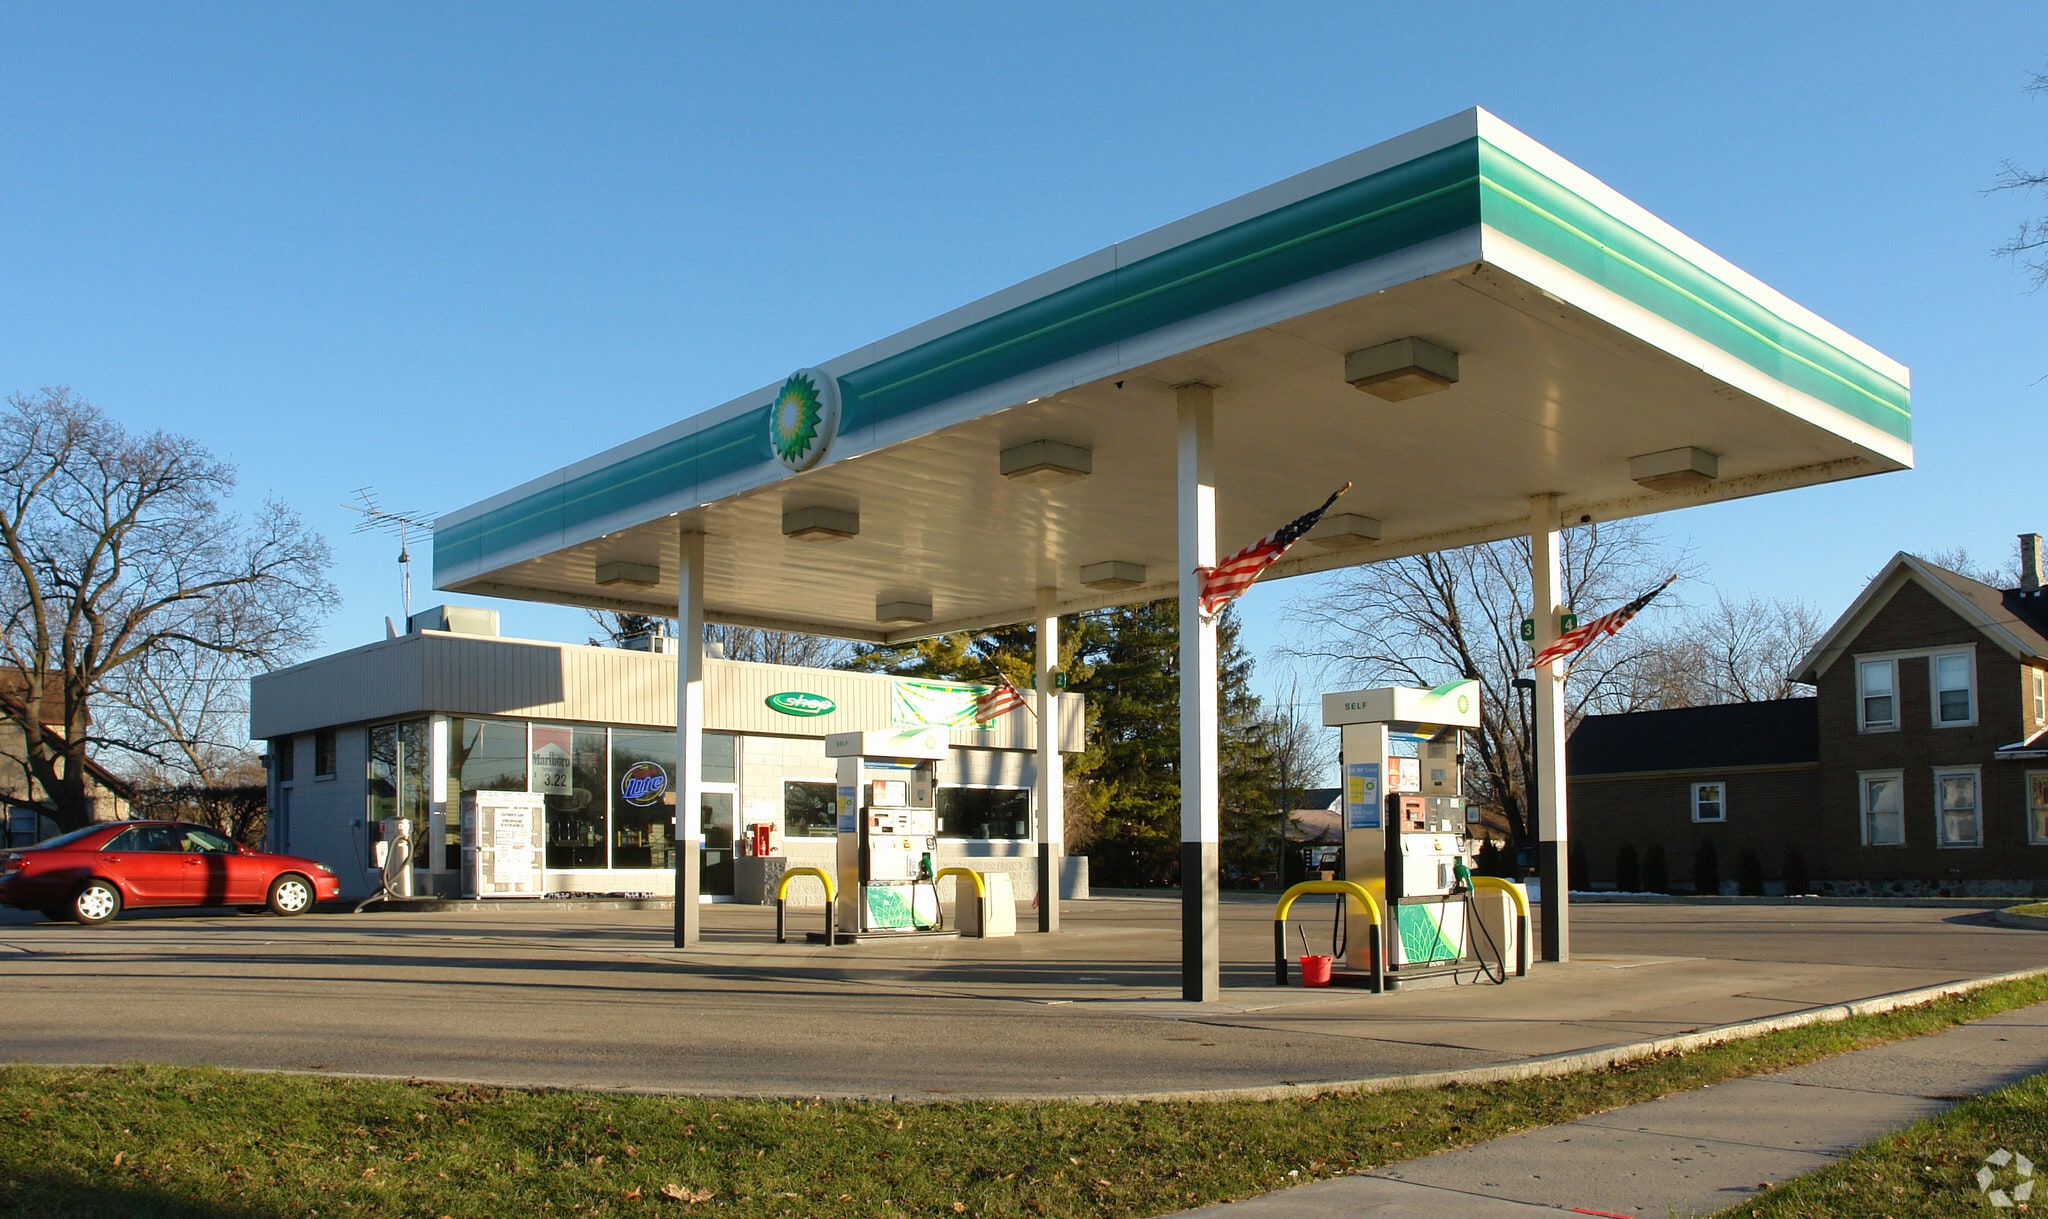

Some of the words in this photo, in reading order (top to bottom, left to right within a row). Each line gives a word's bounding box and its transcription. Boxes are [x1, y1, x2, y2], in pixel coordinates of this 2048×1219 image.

[1524, 623, 1533, 636] 3
[1564, 618, 1574, 631] 4
[1056, 675, 1063, 685] 2
[784, 694, 833, 714] shop
[1344, 701, 1368, 711] SELF
[835, 740, 848, 748] SELF
[531, 751, 571, 768] Marlboro
[544, 773, 567, 787] 3.22
[622, 775, 665, 799] Lite
